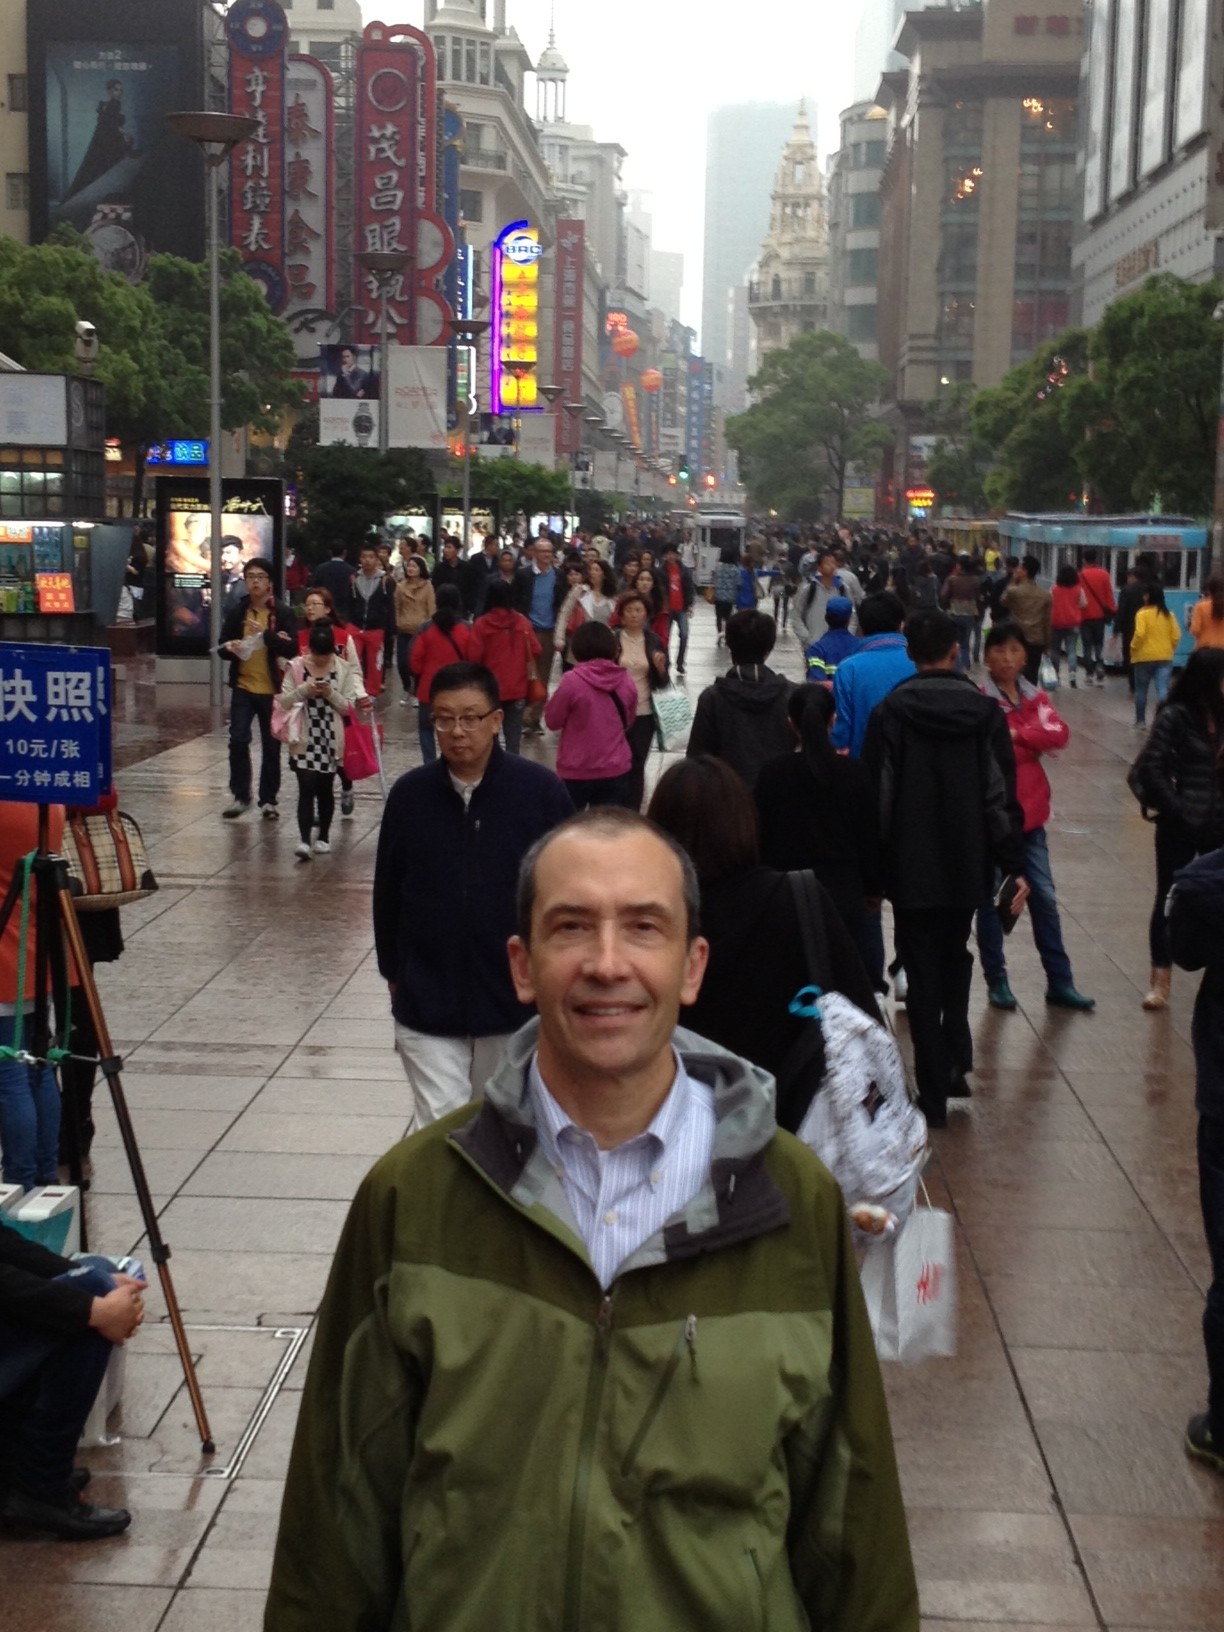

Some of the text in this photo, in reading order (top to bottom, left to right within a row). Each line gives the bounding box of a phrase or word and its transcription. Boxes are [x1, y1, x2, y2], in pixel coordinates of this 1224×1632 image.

[0, 668, 94, 723] 快照
[5, 739, 81, 759] 10元/张
[0, 769, 91, 788] 一分钟成相
